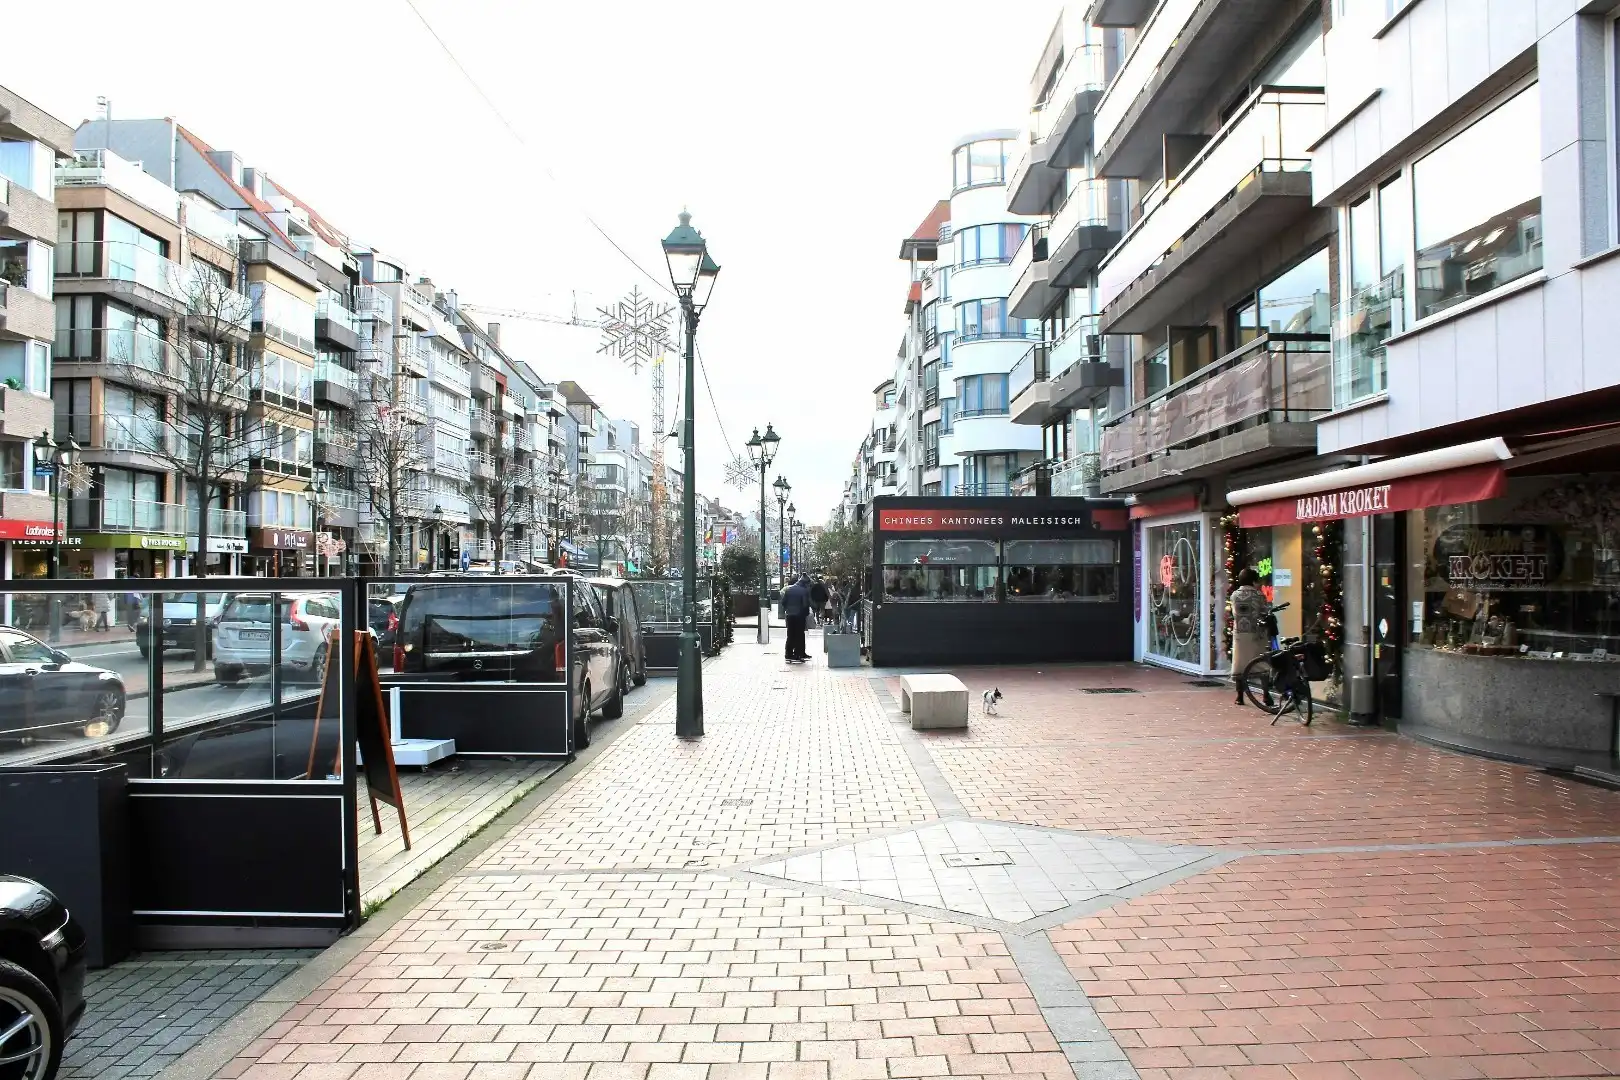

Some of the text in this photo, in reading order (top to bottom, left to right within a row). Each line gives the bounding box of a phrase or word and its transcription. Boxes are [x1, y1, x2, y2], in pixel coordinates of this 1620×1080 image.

[1296, 484, 1391, 519] MADAM KROKET
[884, 517, 1081, 525] CHINEES KANTONEES MALEISISCH
[40, 537, 82, 545] ROHER
[1448, 551, 1549, 580] KROKET
